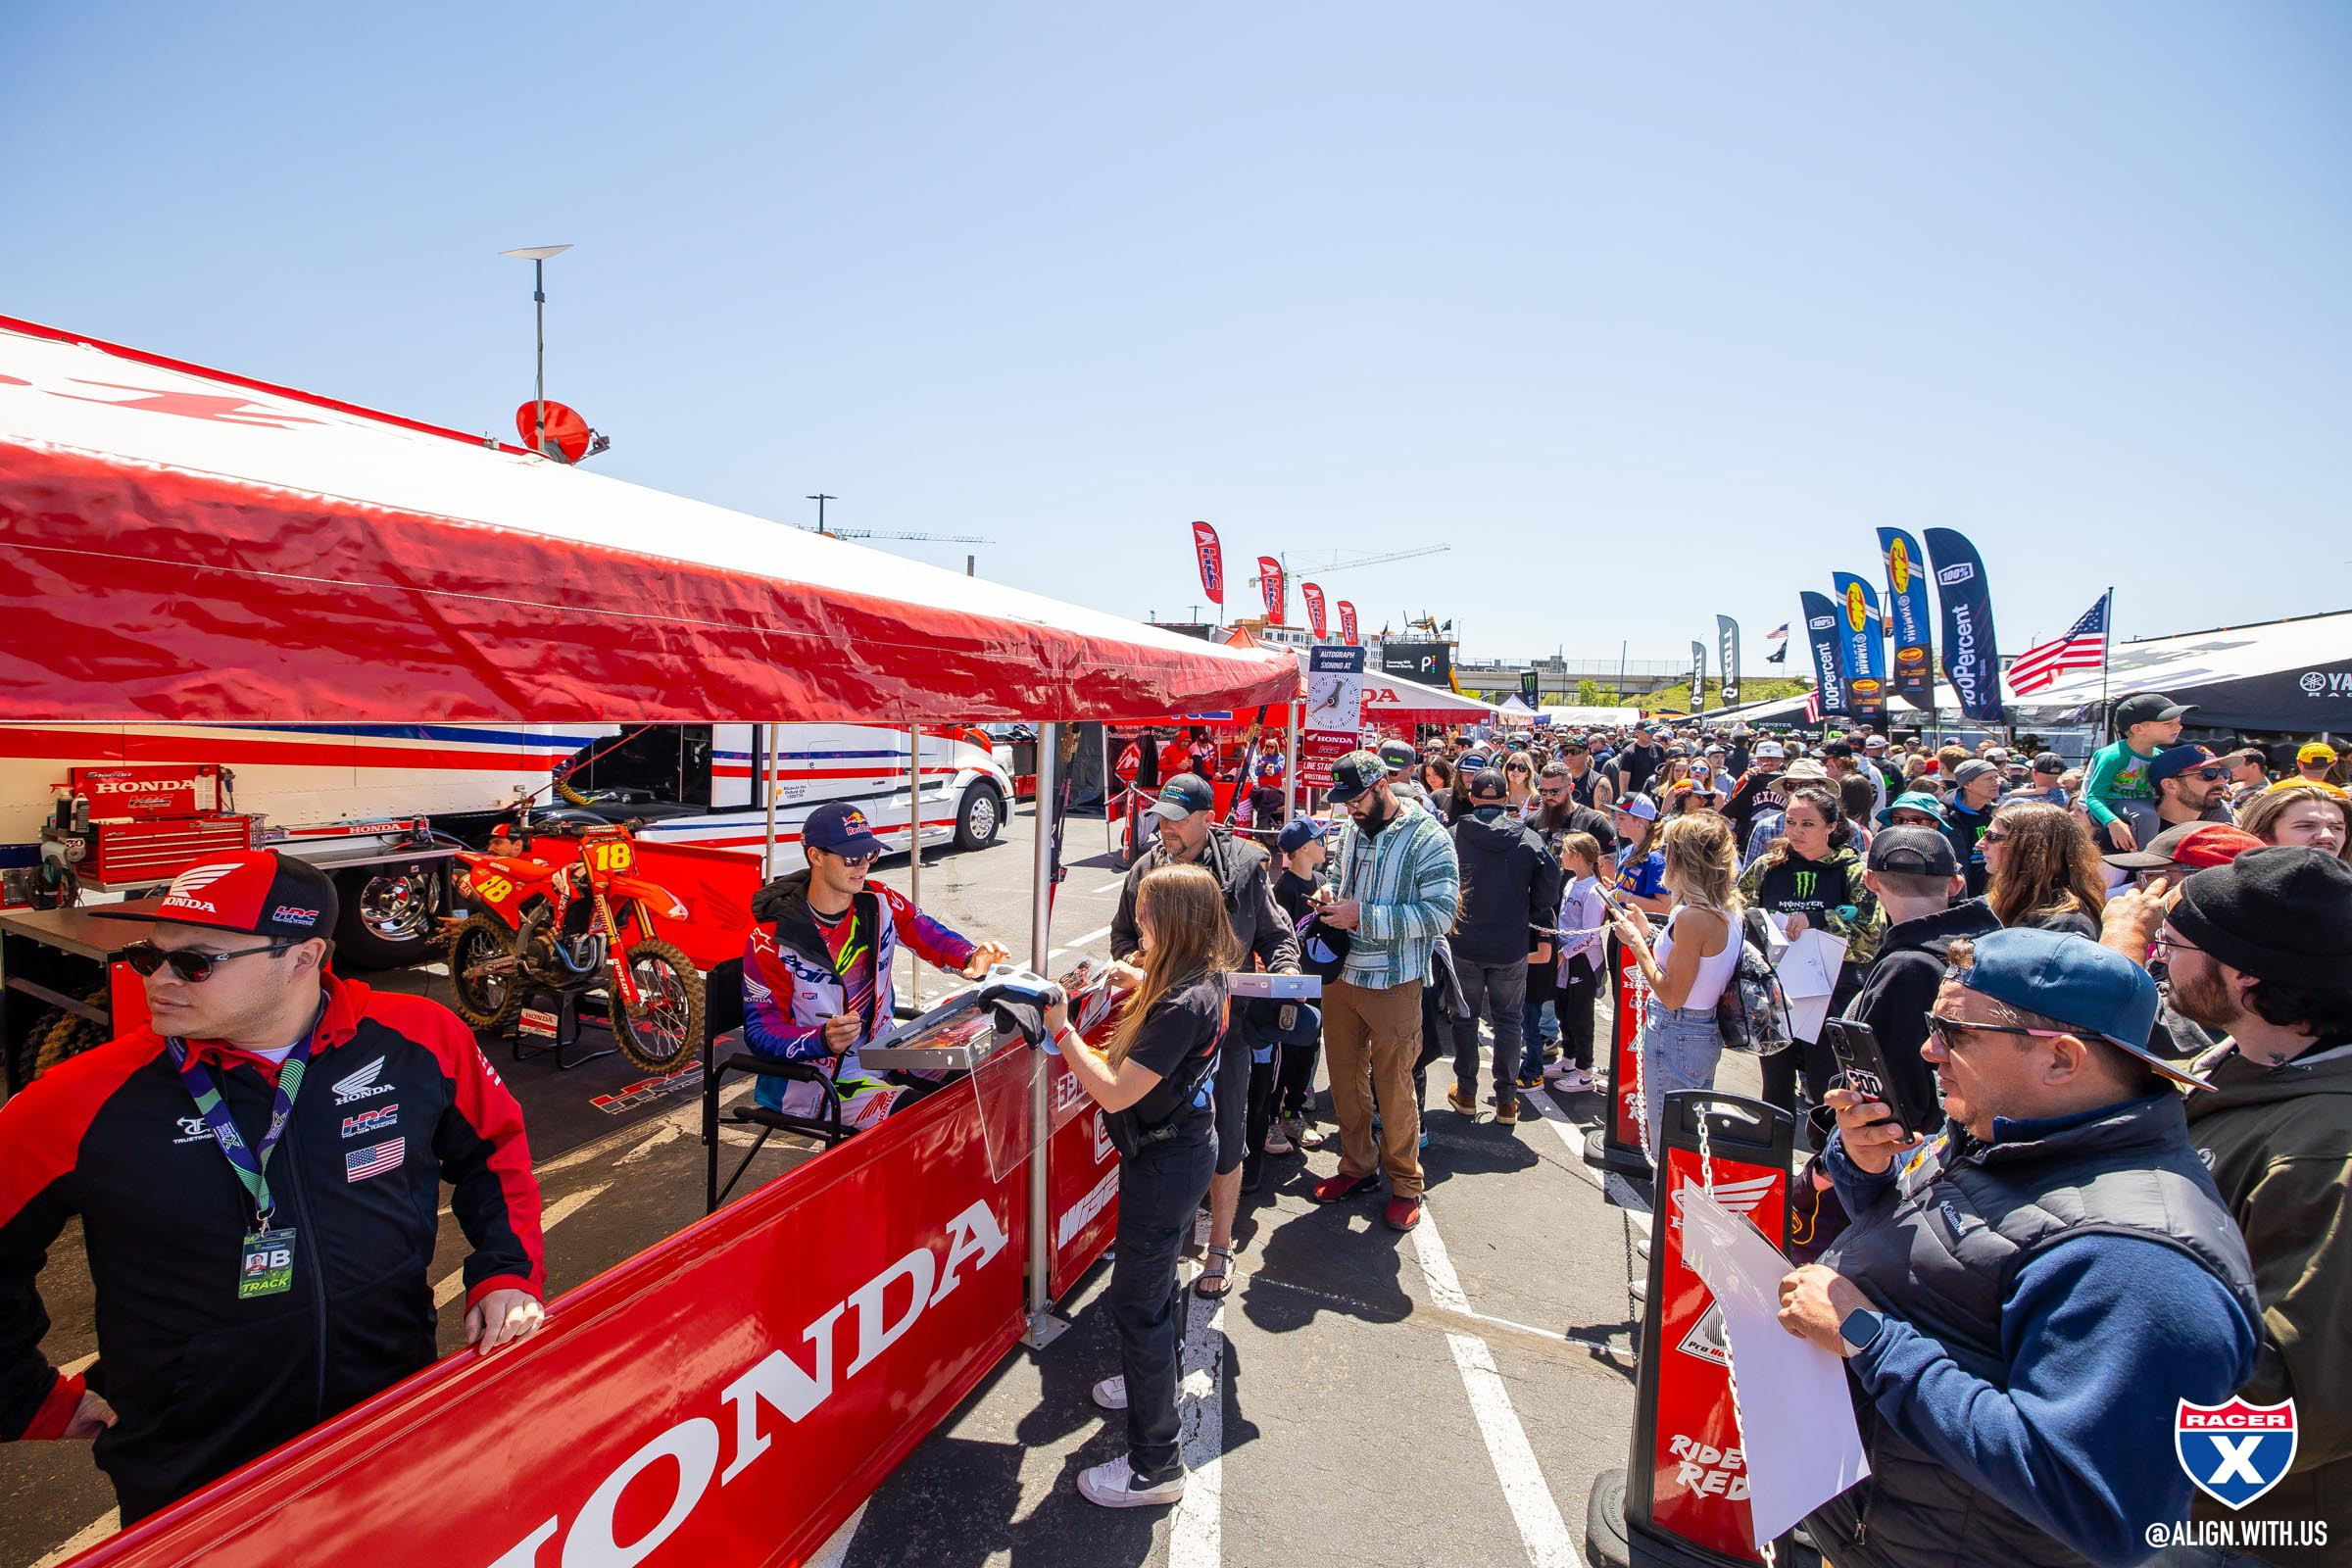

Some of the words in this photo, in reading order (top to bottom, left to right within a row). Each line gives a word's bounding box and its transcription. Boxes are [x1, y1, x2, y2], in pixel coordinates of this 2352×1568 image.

[1942, 565, 1970, 582] 100%
[1952, 604, 1978, 707] 100Percent
[1816, 642, 1839, 710] 100Percent
[1303, 760, 1317, 770] LINE
[96, 780, 195, 794] HONDA
[349, 823, 402, 834] HONDA
[596, 843, 631, 871] 18
[475, 875, 513, 903] 18
[273, 906, 319, 922] HRC
[1779, 900, 1825, 908] MONSTER
[612, 957, 632, 997] DUNLOP
[524, 1011, 555, 1023] HONDA
[335, 1083, 396, 1106] HONDA
[342, 1103, 399, 1136] HRC
[1942, 1204, 1967, 1238] Columbia
[270, 1249, 291, 1268] B
[241, 1277, 289, 1293] TRACK
[1688, 1341, 1708, 1352] Pro
[1669, 1434, 1742, 1470] RIDE
[1676, 1460, 1751, 1501] RED
